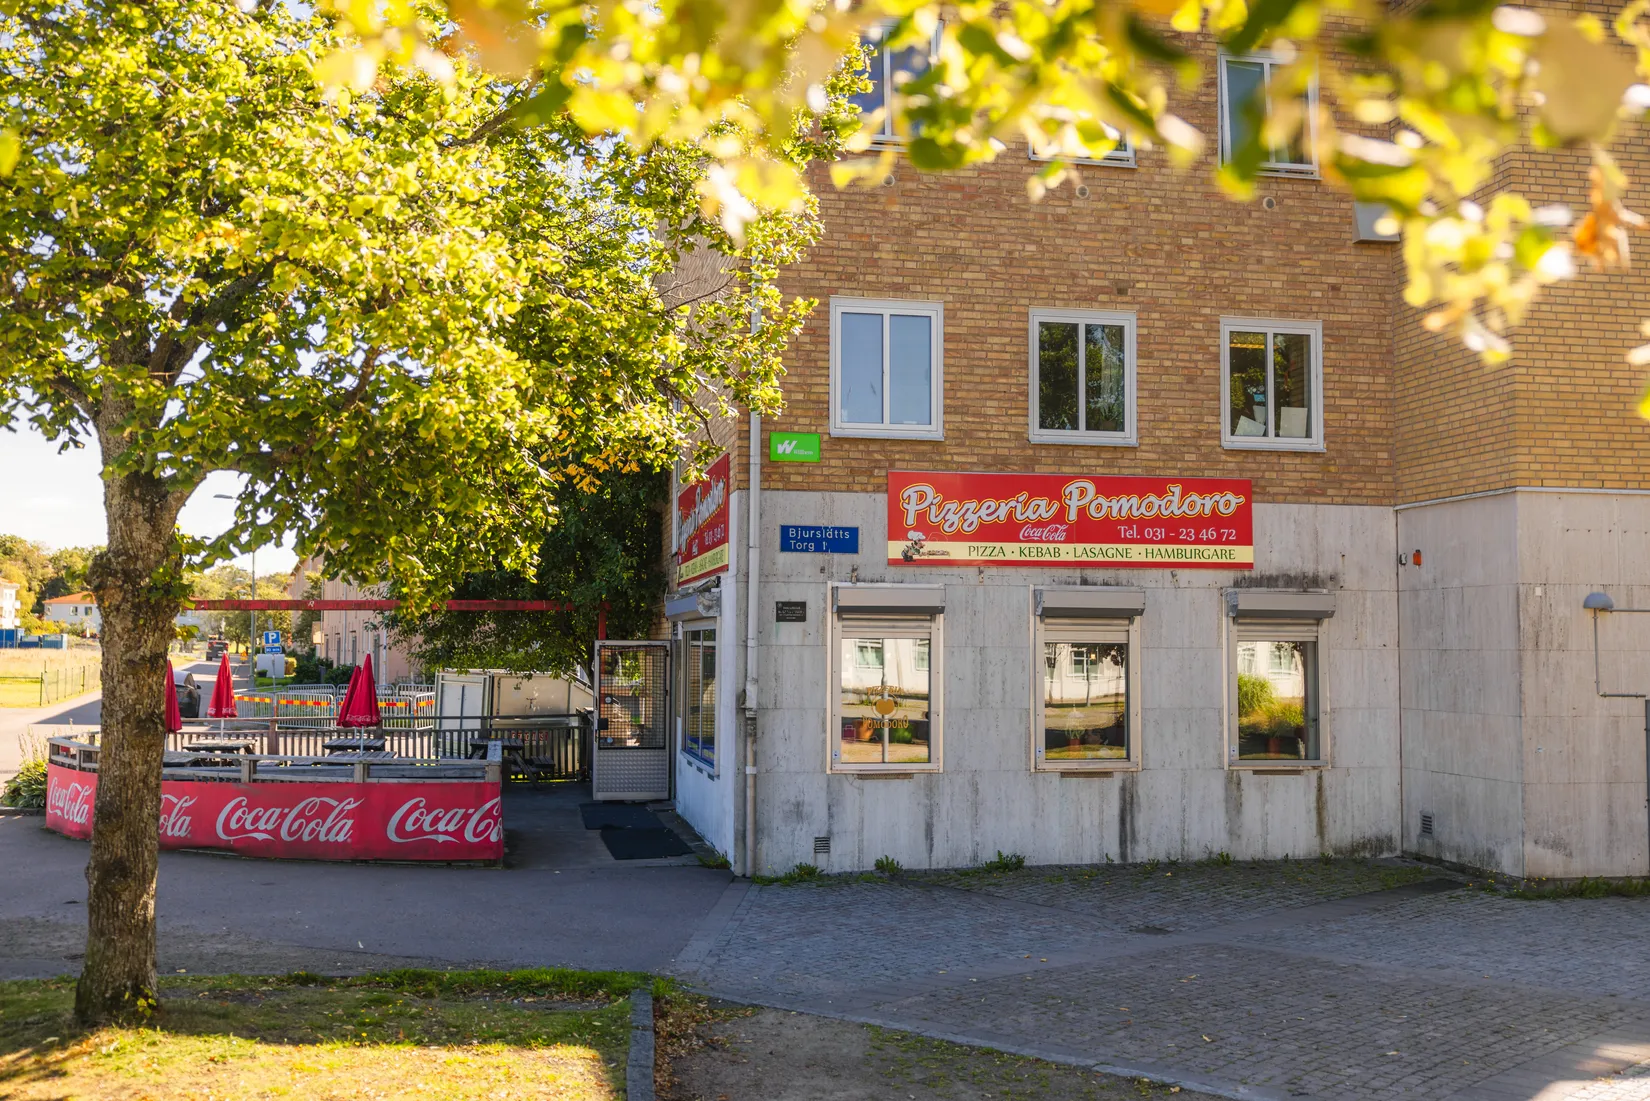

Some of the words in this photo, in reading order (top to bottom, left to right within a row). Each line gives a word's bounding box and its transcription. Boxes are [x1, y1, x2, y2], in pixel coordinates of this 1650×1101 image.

[1062, 480, 1245, 523] Pomodoro
[789, 528, 850, 539] Bjurslätts
[1019, 524, 1069, 541] Coca-Cola
[1118, 525, 1140, 539] Tel.
[1145, 528, 1165, 541] 031
[1179, 528, 1195, 541] 23
[1199, 528, 1216, 541] 46
[1221, 529, 1237, 541] 72
[790, 540, 815, 552] Torg
[968, 545, 1006, 557] PIZZA
[1019, 546, 1061, 558] KEBAB
[1074, 547, 1132, 559] LASAGNE
[1145, 548, 1236, 560] HAMBURGARE
[48, 777, 93, 824] Coca-Cola
[216, 796, 365, 843] Coca-Cola
